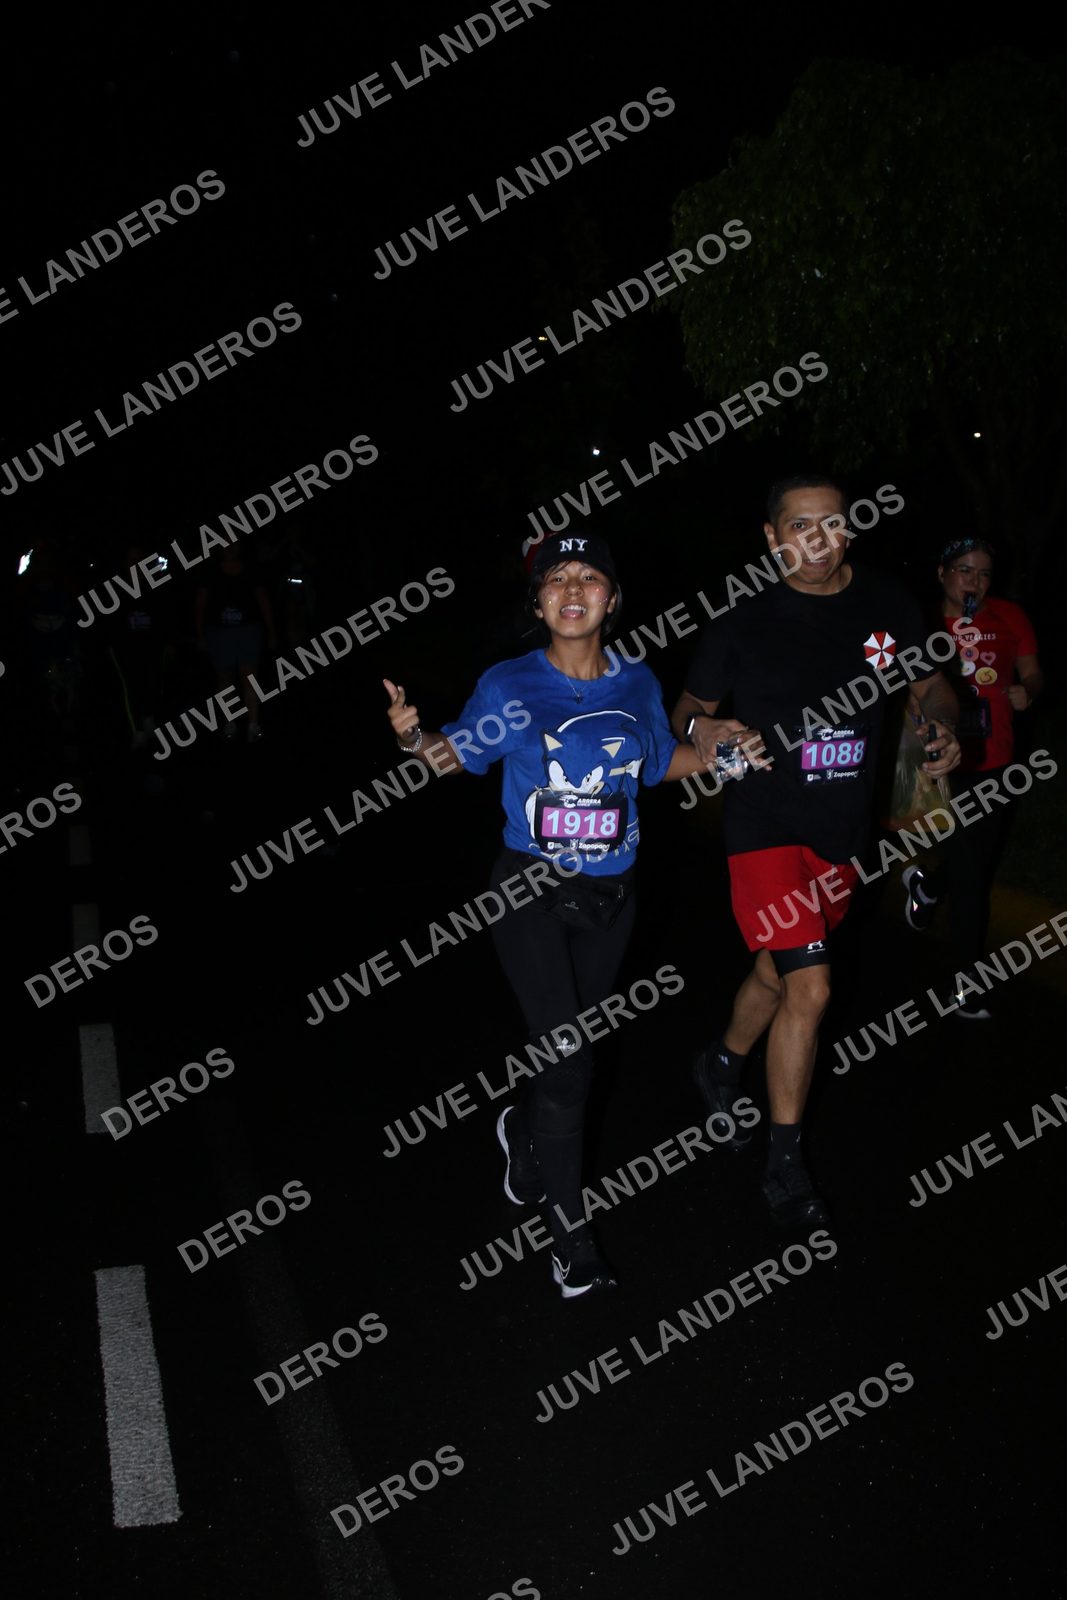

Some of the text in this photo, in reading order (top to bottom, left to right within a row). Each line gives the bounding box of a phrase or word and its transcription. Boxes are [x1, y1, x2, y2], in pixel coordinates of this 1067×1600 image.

[559, 538, 588, 552] NY
[806, 740, 865, 767] 1088
[547, 810, 617, 836] 1918
